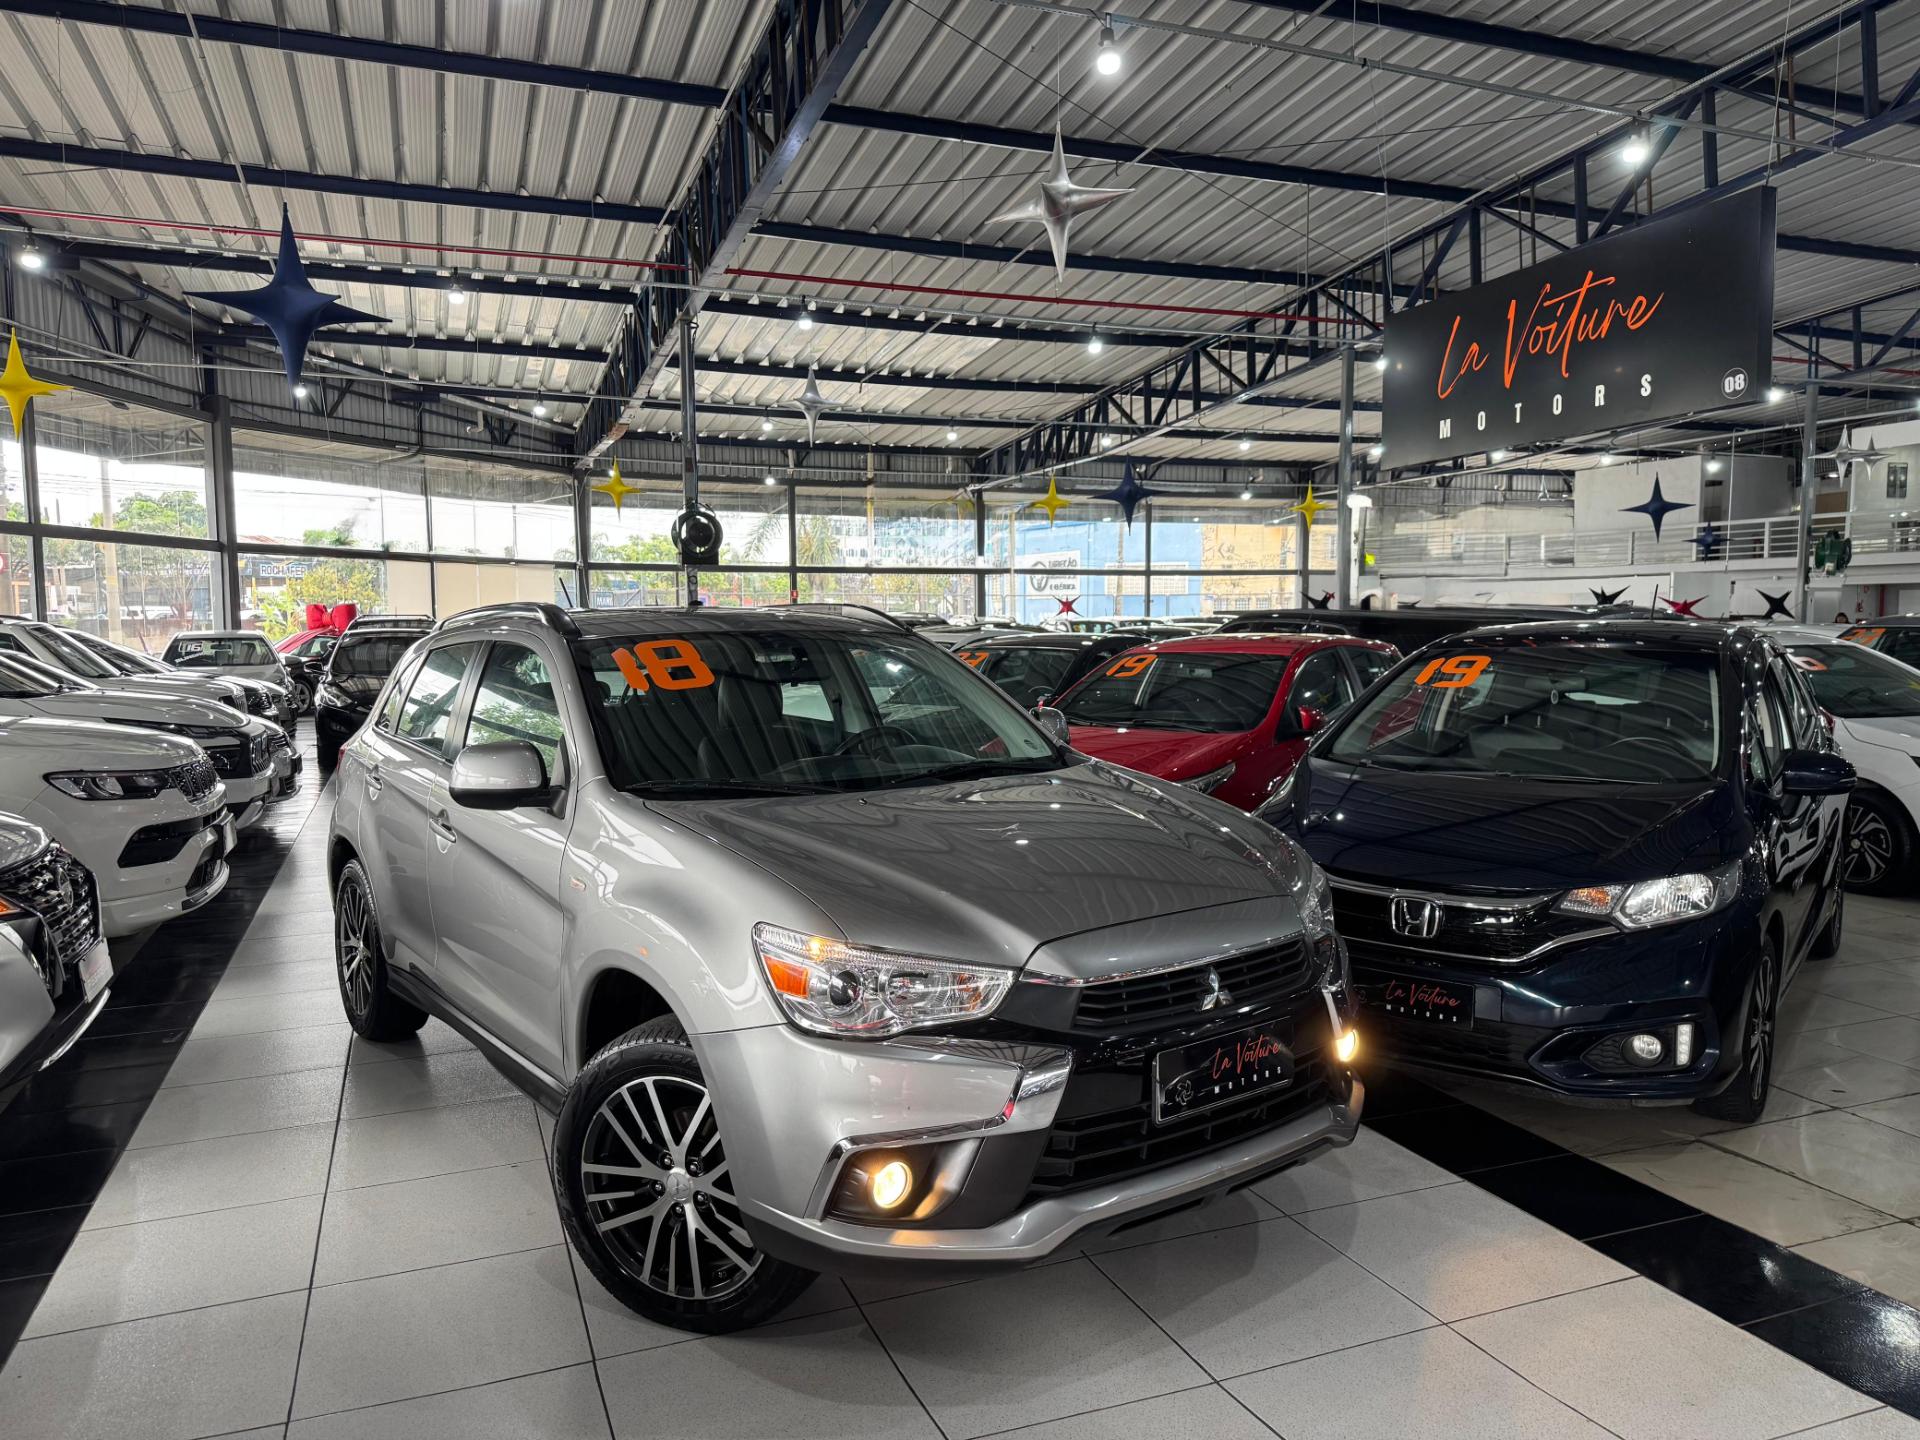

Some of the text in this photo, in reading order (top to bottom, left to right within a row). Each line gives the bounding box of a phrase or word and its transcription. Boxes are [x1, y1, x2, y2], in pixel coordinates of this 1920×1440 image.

[1437, 270, 1665, 399] La Voiture
[1724, 373, 1745, 393] 08
[1438, 374, 1652, 440] MOTORS
[611, 639, 715, 692] 18
[1106, 654, 1158, 678] 19
[1414, 655, 1492, 688] 19
[1385, 980, 1461, 1010] La Voiture
[1212, 1034, 1283, 1080] La Voiture
